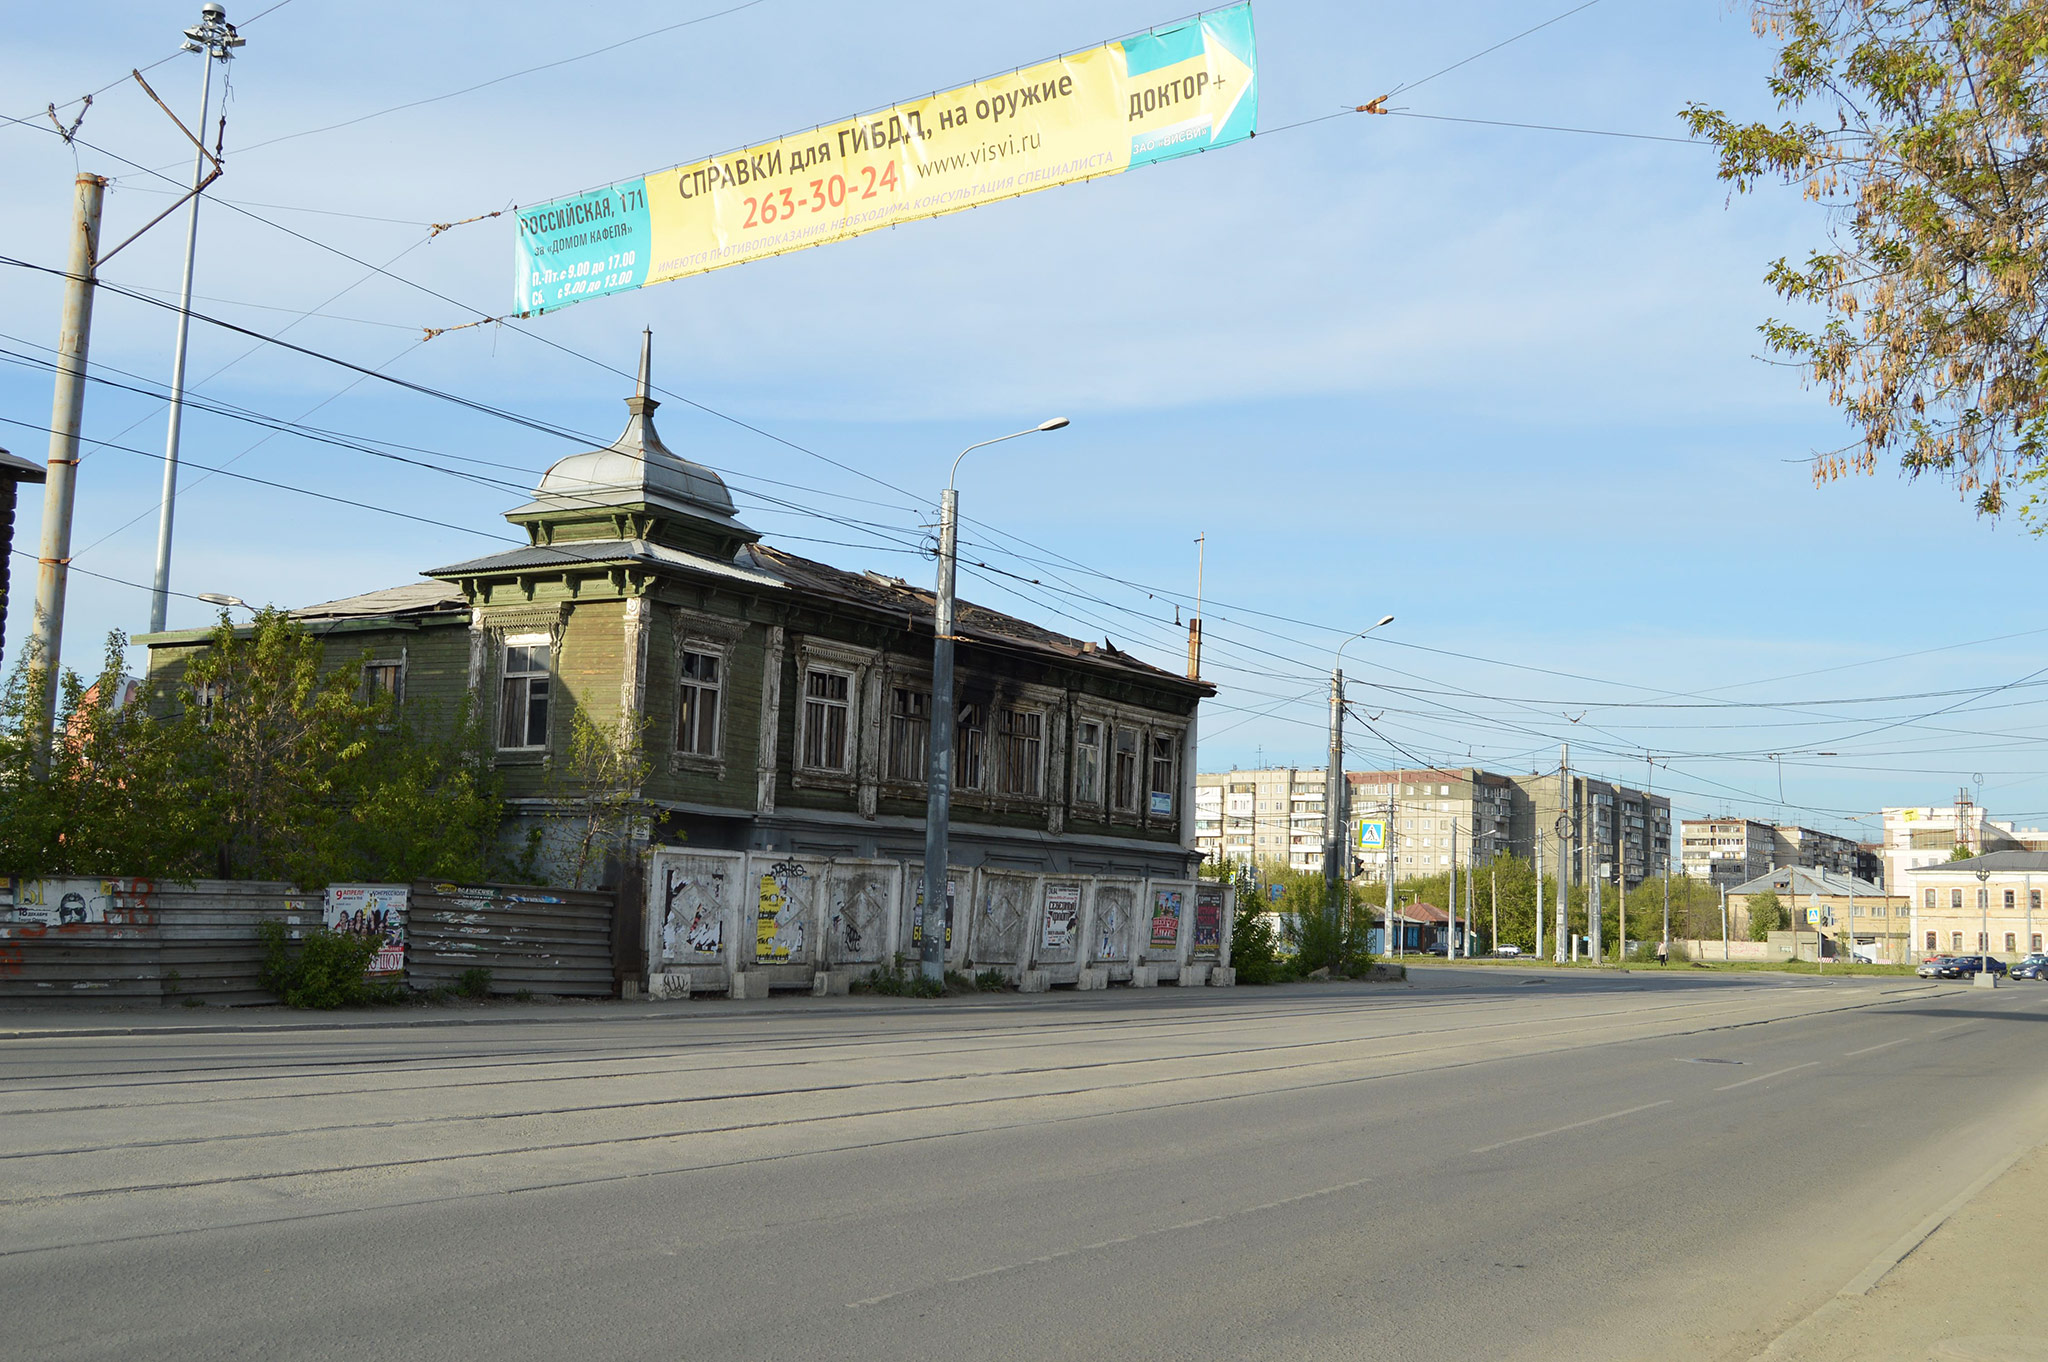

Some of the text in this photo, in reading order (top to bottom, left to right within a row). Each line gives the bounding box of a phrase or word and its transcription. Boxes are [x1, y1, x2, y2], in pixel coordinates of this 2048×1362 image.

[679, 75, 1073, 199] СПРАВКИ для ГИБДД, на оружие
[1132, 140, 1155, 156] ЗАО
[917, 132, 1042, 178] www.visvi.ru
[658, 150, 1113, 274] ИМЕЮТСЯ ПРОТИВОПОКАЗАНИЯ. НЕОБХОДИМА КОНСУЛЬТАЦИЯ СПЕЦИАЛИСТА
[742, 160, 898, 229] 263-30-24
[520, 188, 644, 237] РОССИЙСКАЯ, 171
[534, 222, 633, 257] за «ДОМОМ КАФЕЛЯ»
[591, 261, 605, 275] до
[608, 250, 636, 273] 17.00
[586, 280, 601, 294] до
[604, 270, 633, 289] 13.00
[335, 890, 342, 900] 9
[368, 951, 402, 971] О-ШОУ
